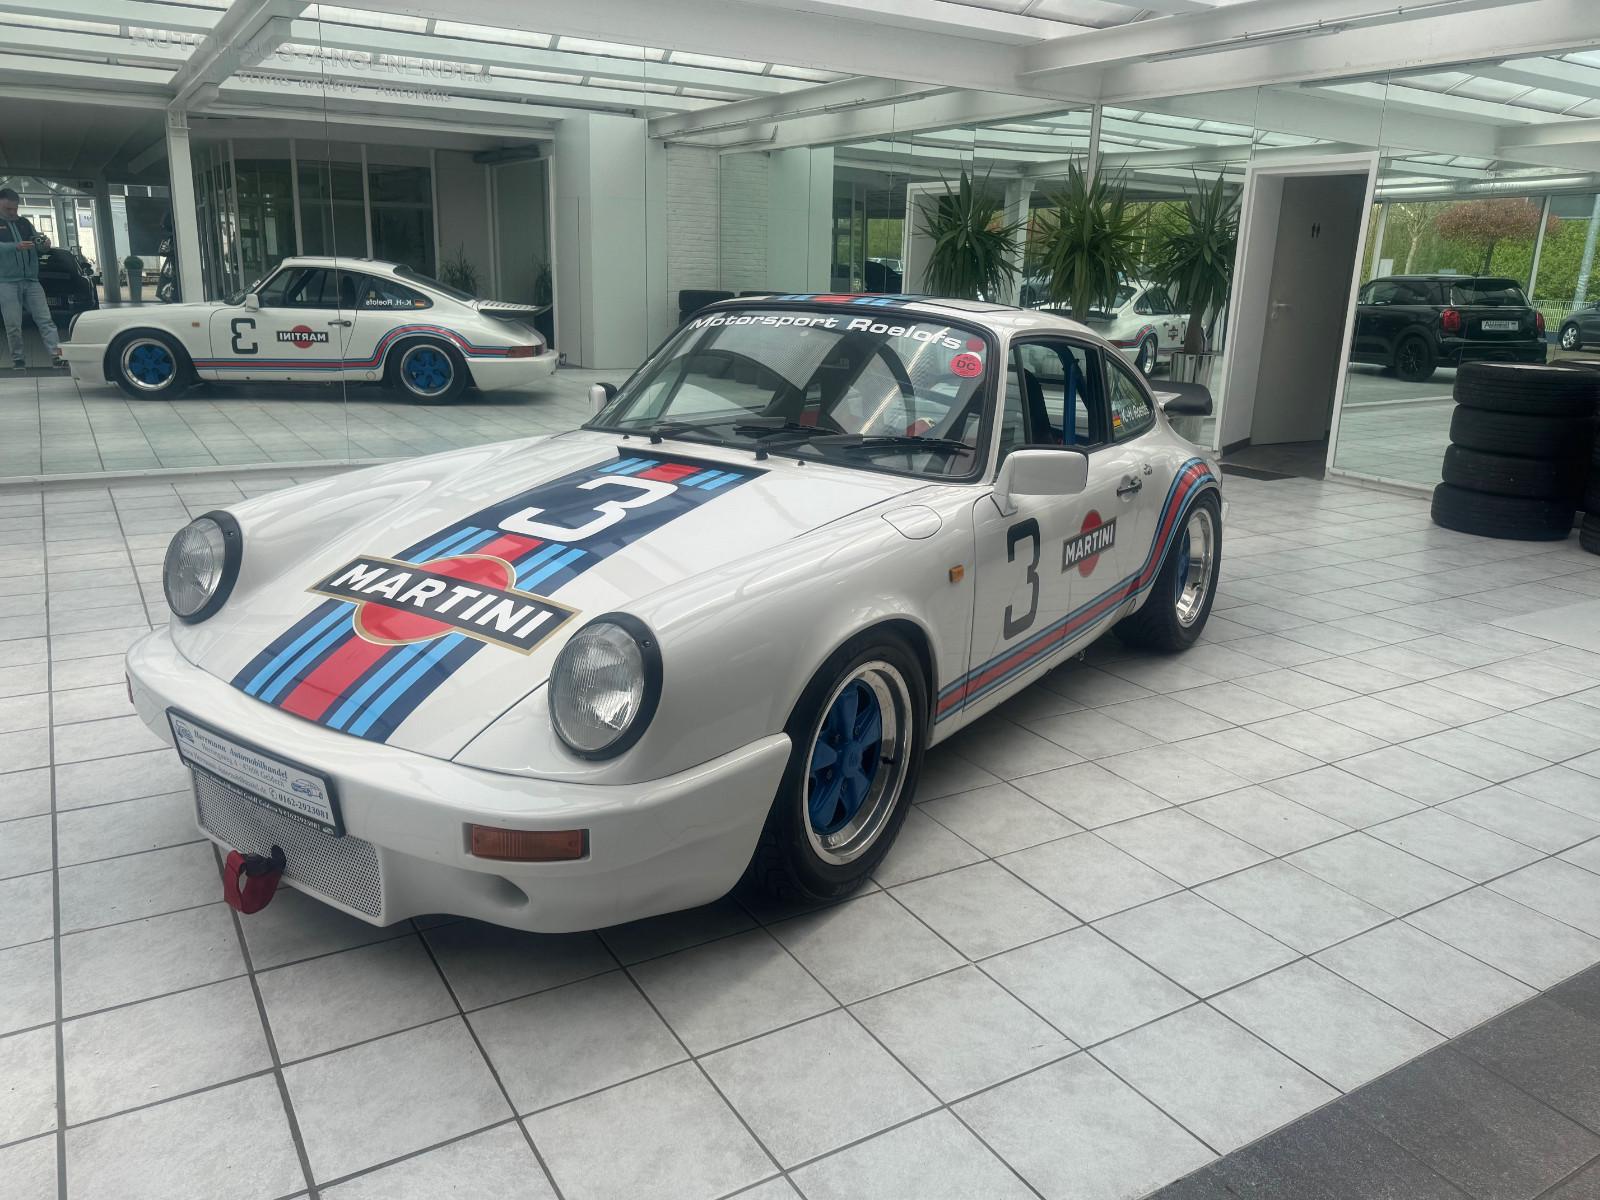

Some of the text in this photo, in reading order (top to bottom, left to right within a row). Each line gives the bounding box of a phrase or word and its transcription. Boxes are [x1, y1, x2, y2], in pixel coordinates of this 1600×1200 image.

[688, 315, 962, 350] Motorsport Roelofs
[956, 359, 977, 371] DC
[498, 475, 679, 542] 3
[1064, 523, 1114, 566] MARTINI
[1003, 517, 1040, 640] 3
[330, 563, 555, 639] MARTINI
[230, 747, 288, 781] Automobilhandel
